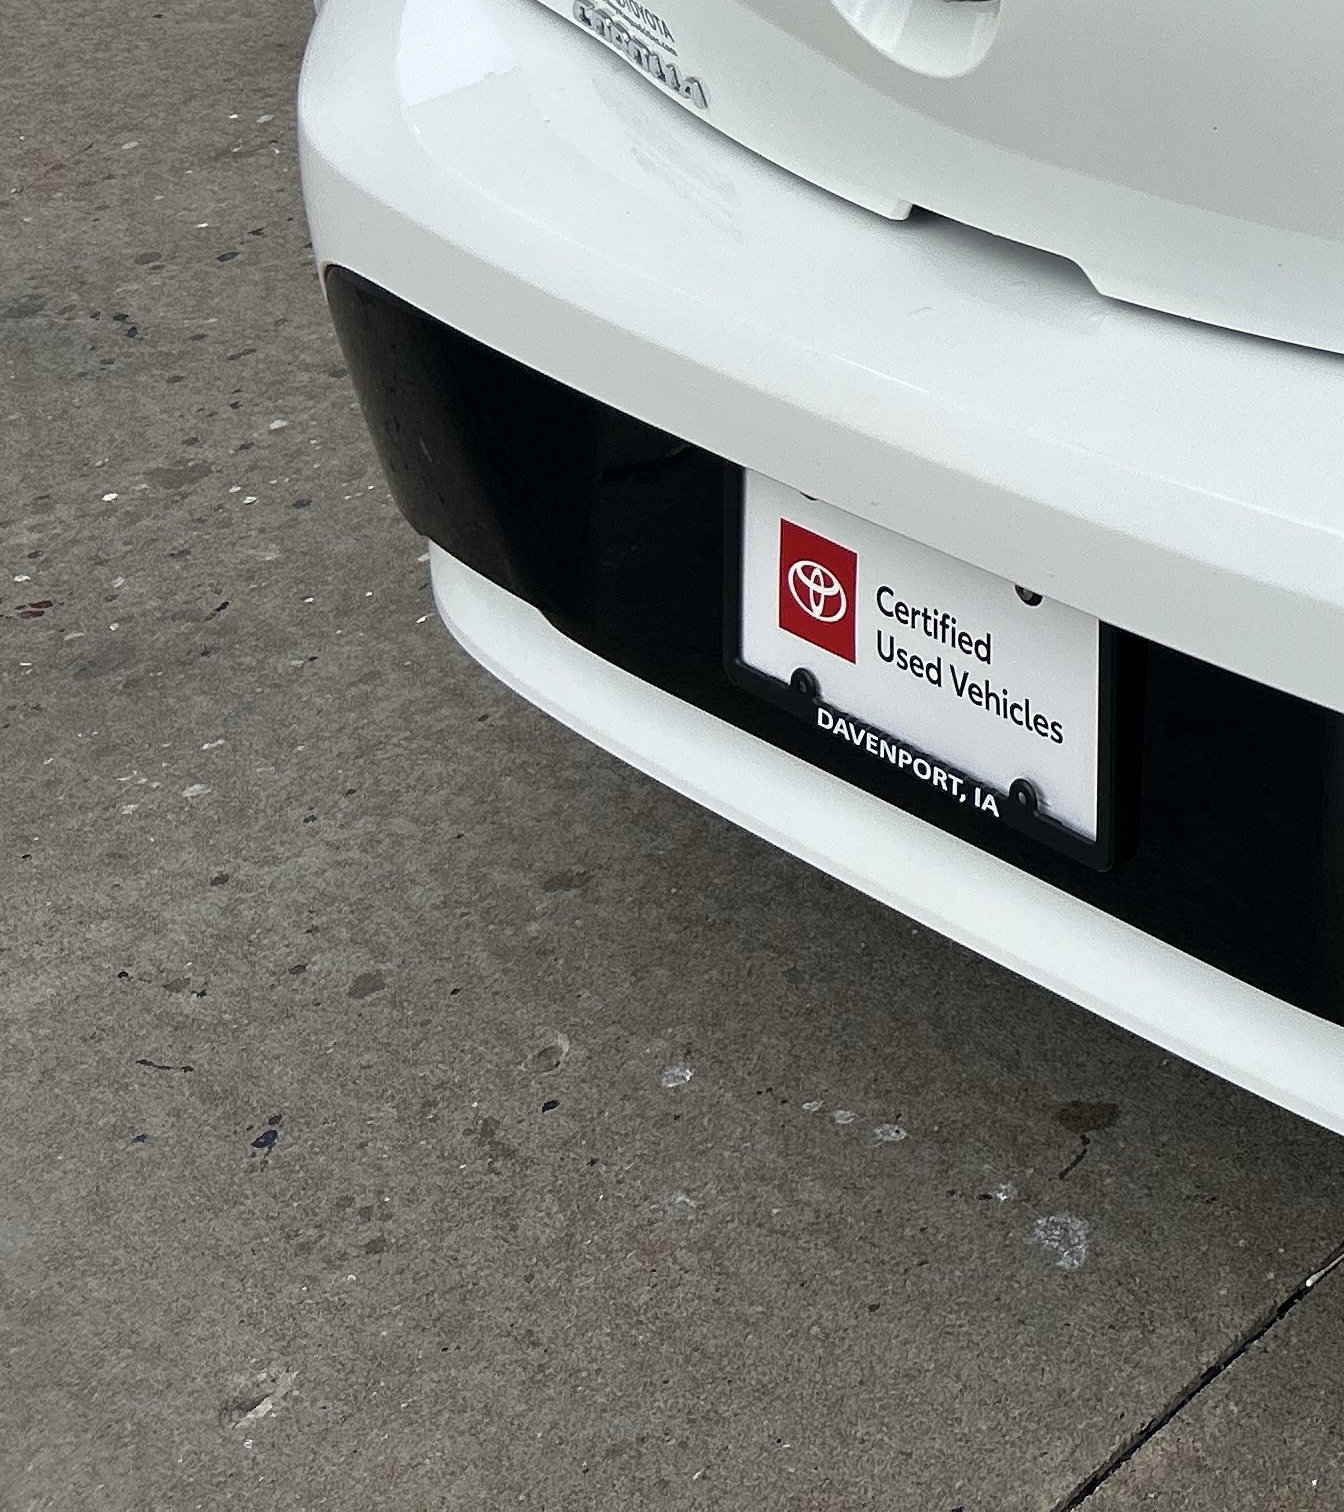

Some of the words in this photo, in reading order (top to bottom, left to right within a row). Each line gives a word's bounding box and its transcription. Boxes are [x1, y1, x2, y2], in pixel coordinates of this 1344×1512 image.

[876, 586, 992, 665] Certified
[876, 629, 943, 688] Used
[949, 664, 1064, 744] Vehicles
[817, 707, 967, 803] DAVENPORT,
[974, 786, 1000, 818] IA
